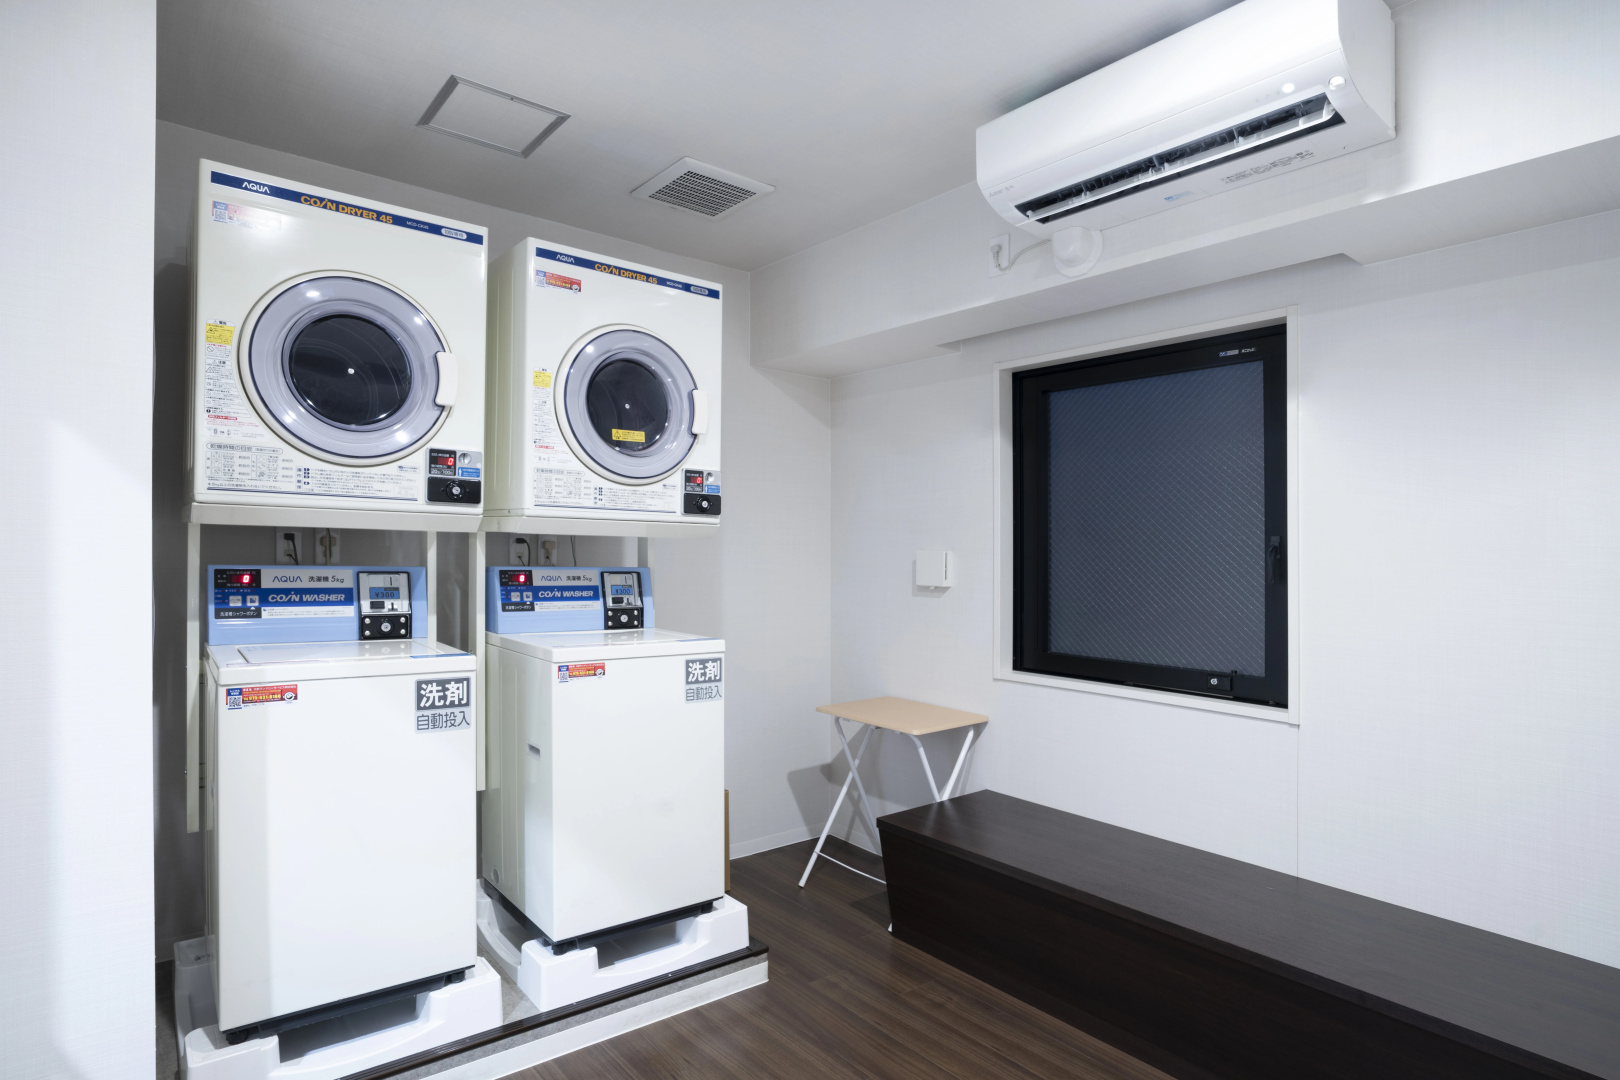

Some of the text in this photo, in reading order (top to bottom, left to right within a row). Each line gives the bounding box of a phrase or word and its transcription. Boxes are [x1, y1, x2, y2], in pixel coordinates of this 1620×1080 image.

[242, 181, 270, 194] AQUA
[338, 204, 377, 221] DRYER
[379, 214, 393, 224] 45
[556, 254, 575, 264] AQUA
[620, 268, 647, 283] DRYER
[648, 277, 658, 285] 45
[243, 575, 250, 583] 0
[272, 575, 303, 583] AQUA
[308, 575, 345, 584] 洗濯機 5kg
[582, 574, 593, 583] 5kg
[302, 593, 345, 602] WASHER
[375, 591, 395, 599] ¥300
[562, 590, 594, 598] WASHER
[687, 661, 721, 683] 洗剤
[419, 681, 468, 709] 洗剤
[685, 683, 722, 702] 自動投入
[416, 711, 470, 732] 自動投入
